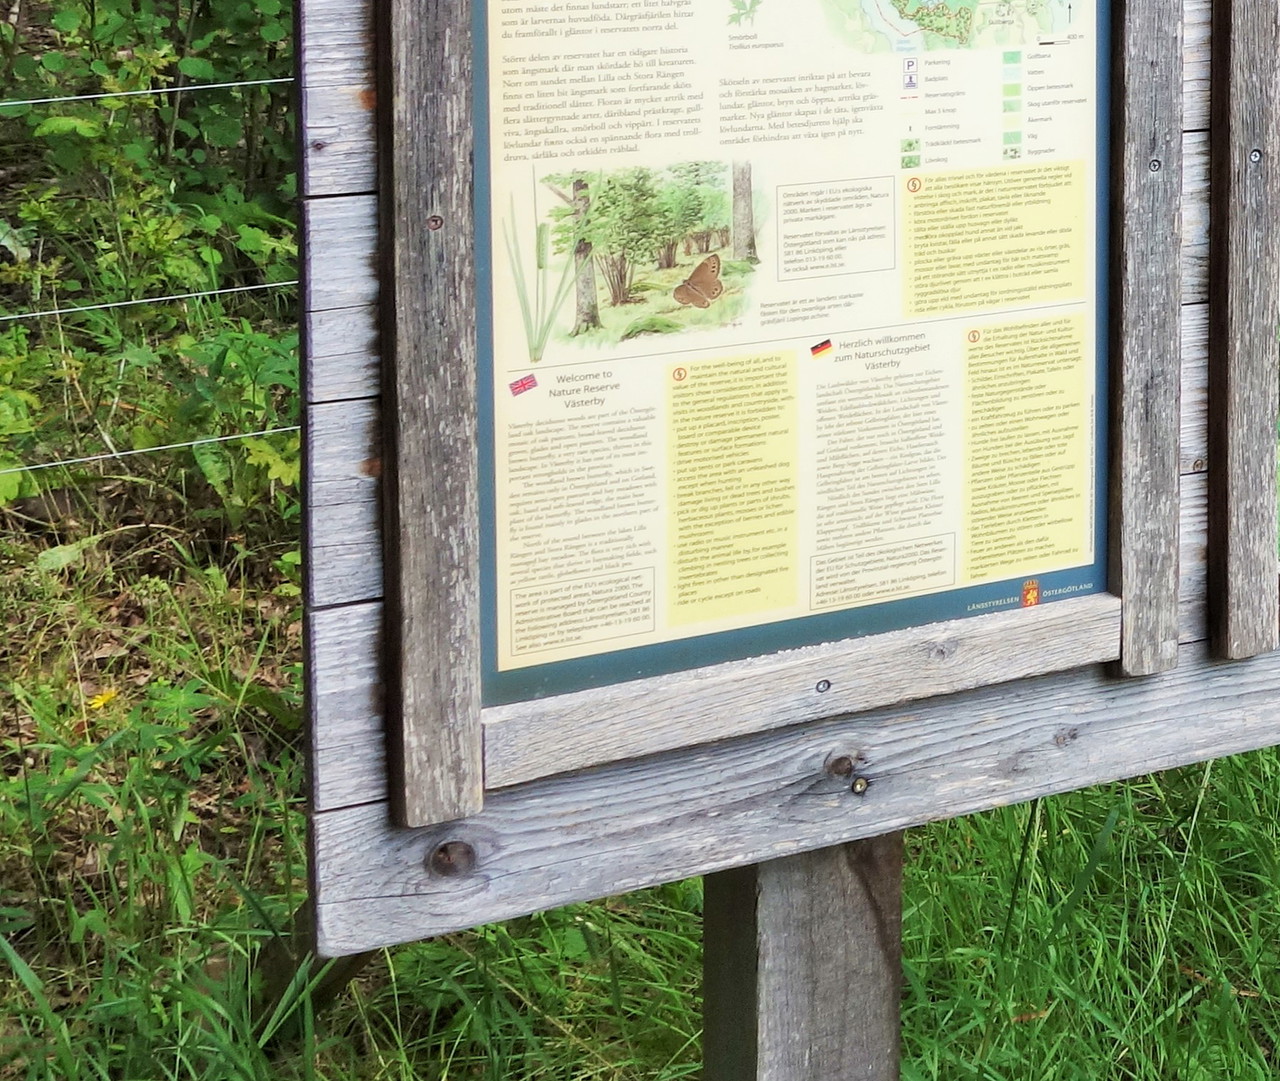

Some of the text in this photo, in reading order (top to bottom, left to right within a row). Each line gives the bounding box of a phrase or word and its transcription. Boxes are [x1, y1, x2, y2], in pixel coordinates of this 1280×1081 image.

[839, 333, 926, 350] Herzlich willkommen
[834, 344, 930, 363] zum Naturschutzgebiet
[865, 360, 901, 371] Västerby
[556, 370, 612, 383] Welcome to
[548, 383, 620, 397] Nature Reserve
[564, 397, 605, 409] Västerby
[967, 582, 1093, 611] LÄNSSTYRELSEN ÖSTERGÖTLAND
